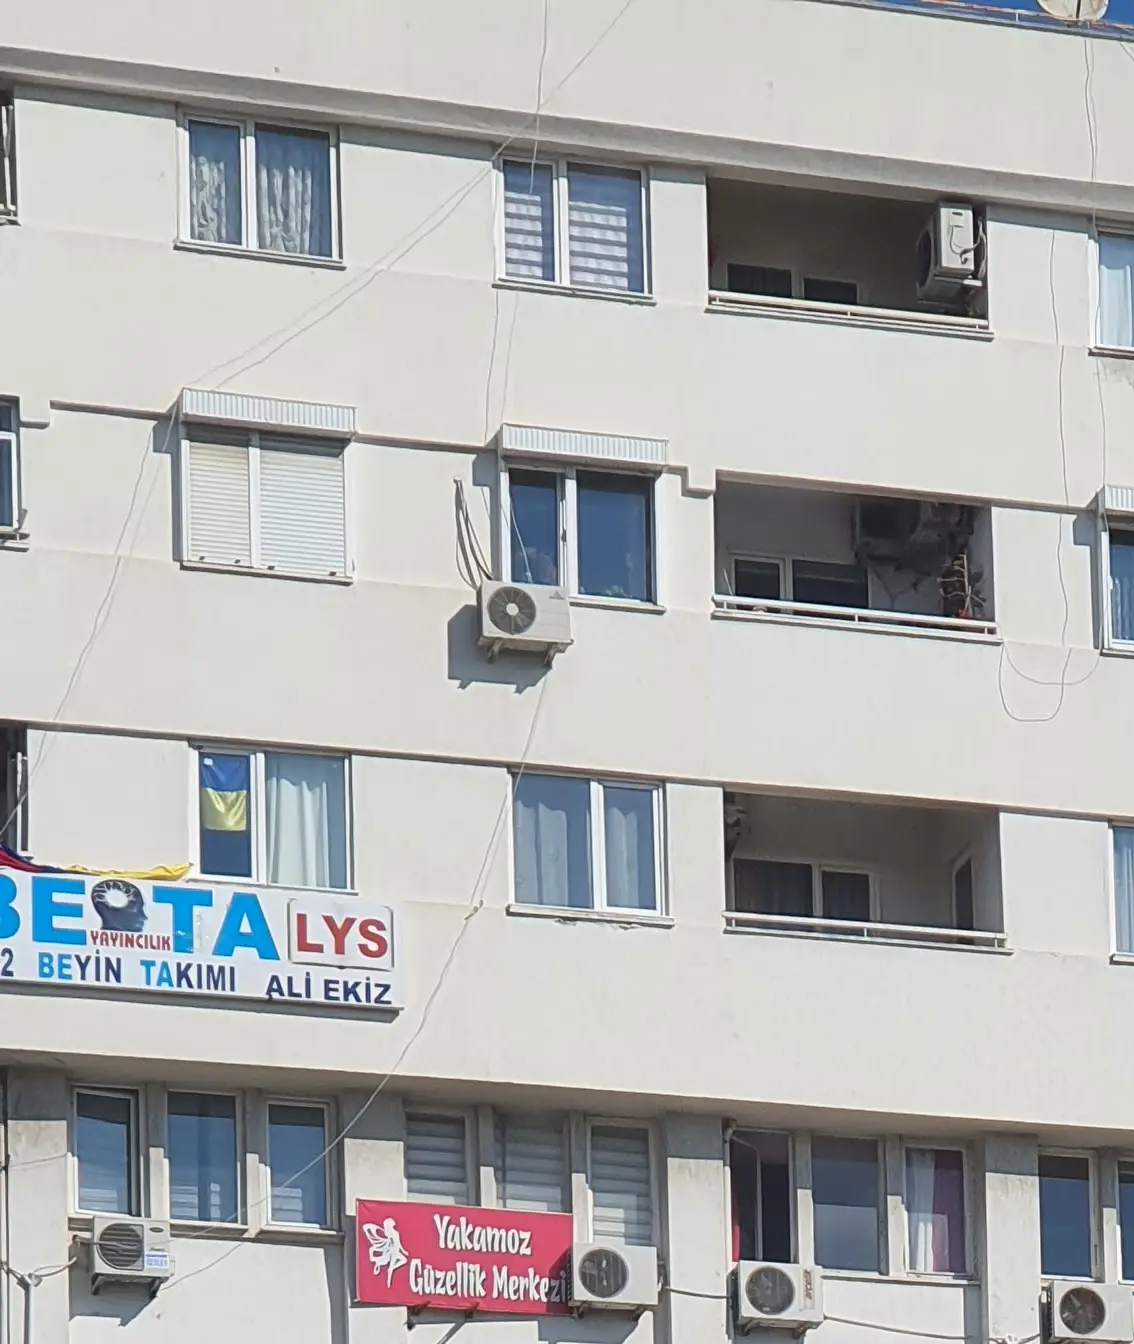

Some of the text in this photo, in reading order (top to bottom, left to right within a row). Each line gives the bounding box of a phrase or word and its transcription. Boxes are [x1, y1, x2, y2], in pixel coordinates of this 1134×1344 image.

[90, 930, 171, 952] YAYINCILIK
[296, 913, 389, 958] LYS
[38, 948, 122, 983] BEYİN
[140, 960, 236, 992] TAKIMI
[266, 966, 312, 999] ALİ
[323, 976, 392, 1005] EKİZ
[433, 1213, 533, 1256] Yakamoz
[409, 1258, 568, 1303] Güzellik Merkezi
